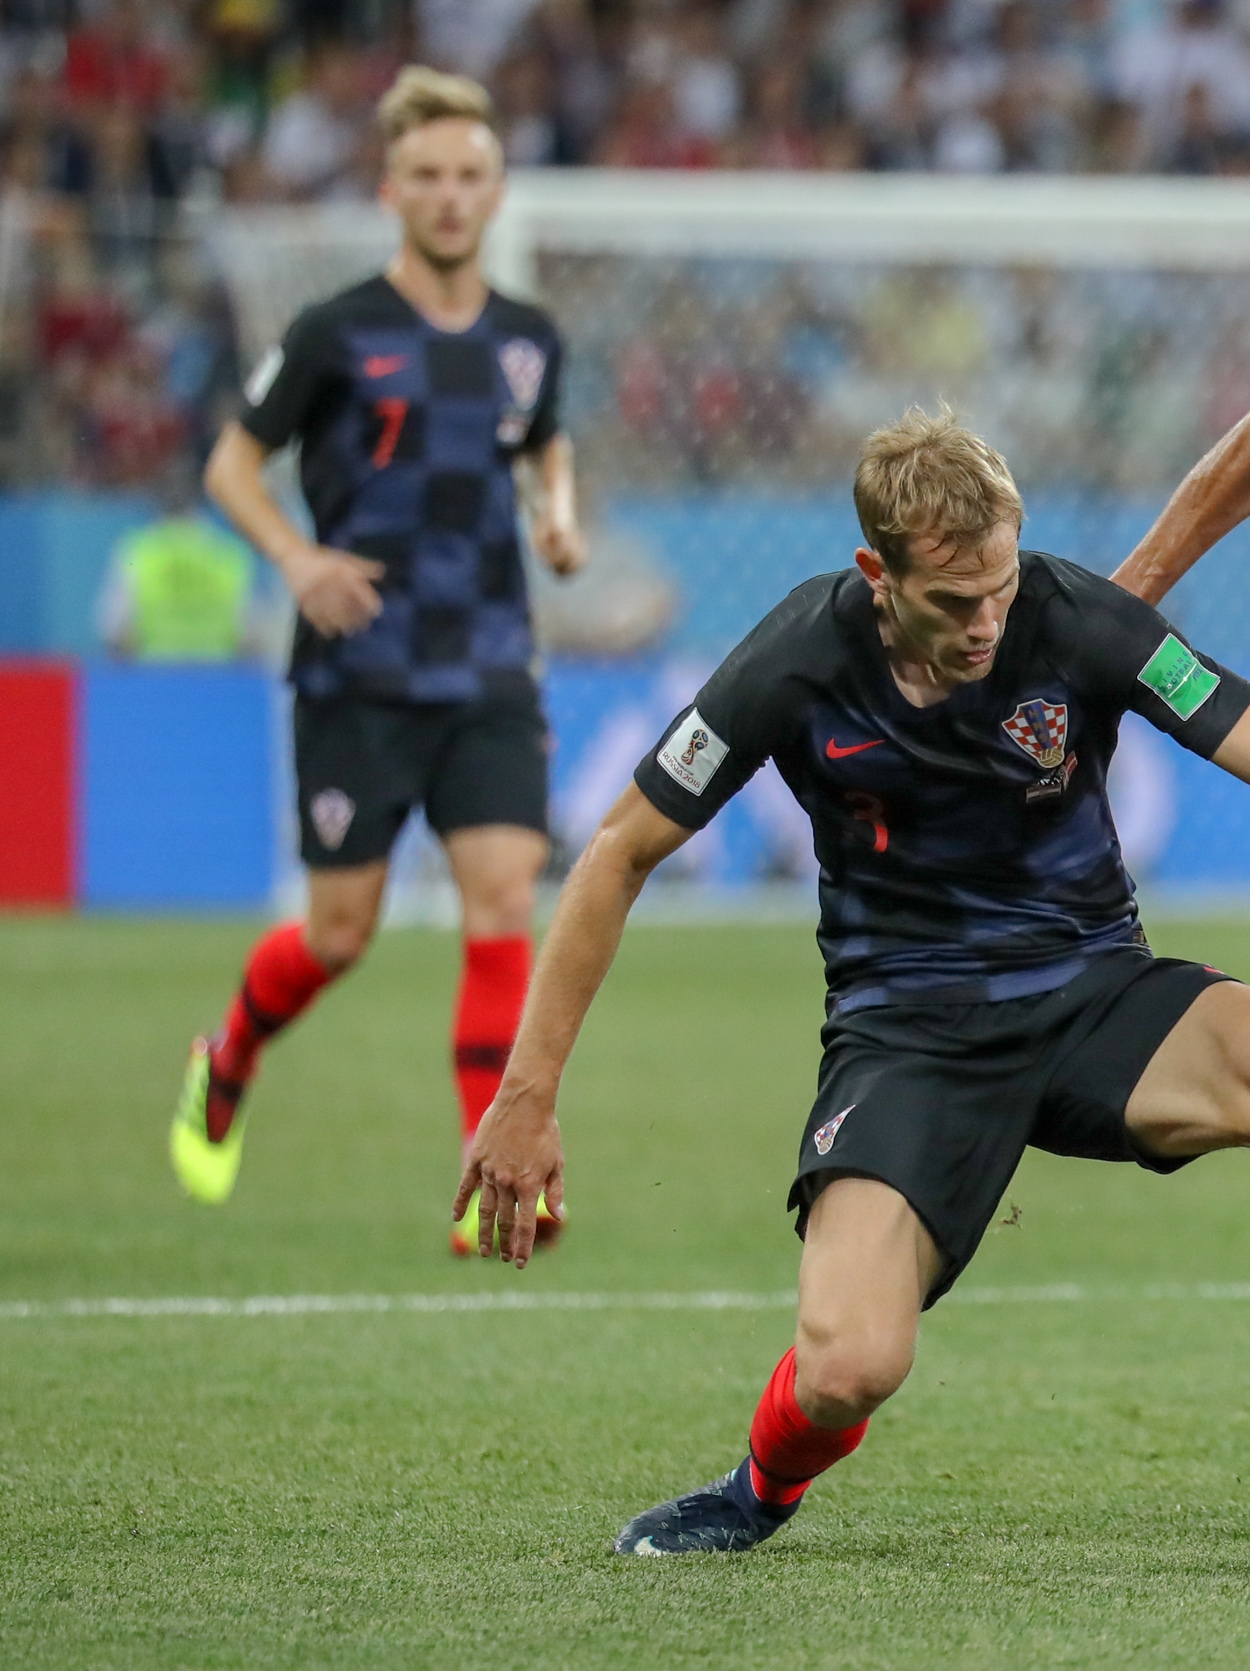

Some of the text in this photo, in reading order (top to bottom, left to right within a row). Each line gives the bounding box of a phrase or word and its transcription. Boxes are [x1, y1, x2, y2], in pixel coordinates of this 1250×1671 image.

[372, 397, 408, 470] 7
[663, 751, 683, 777] RUSSIA
[683, 774, 700, 788] 2018
[844, 789, 889, 853] 3
